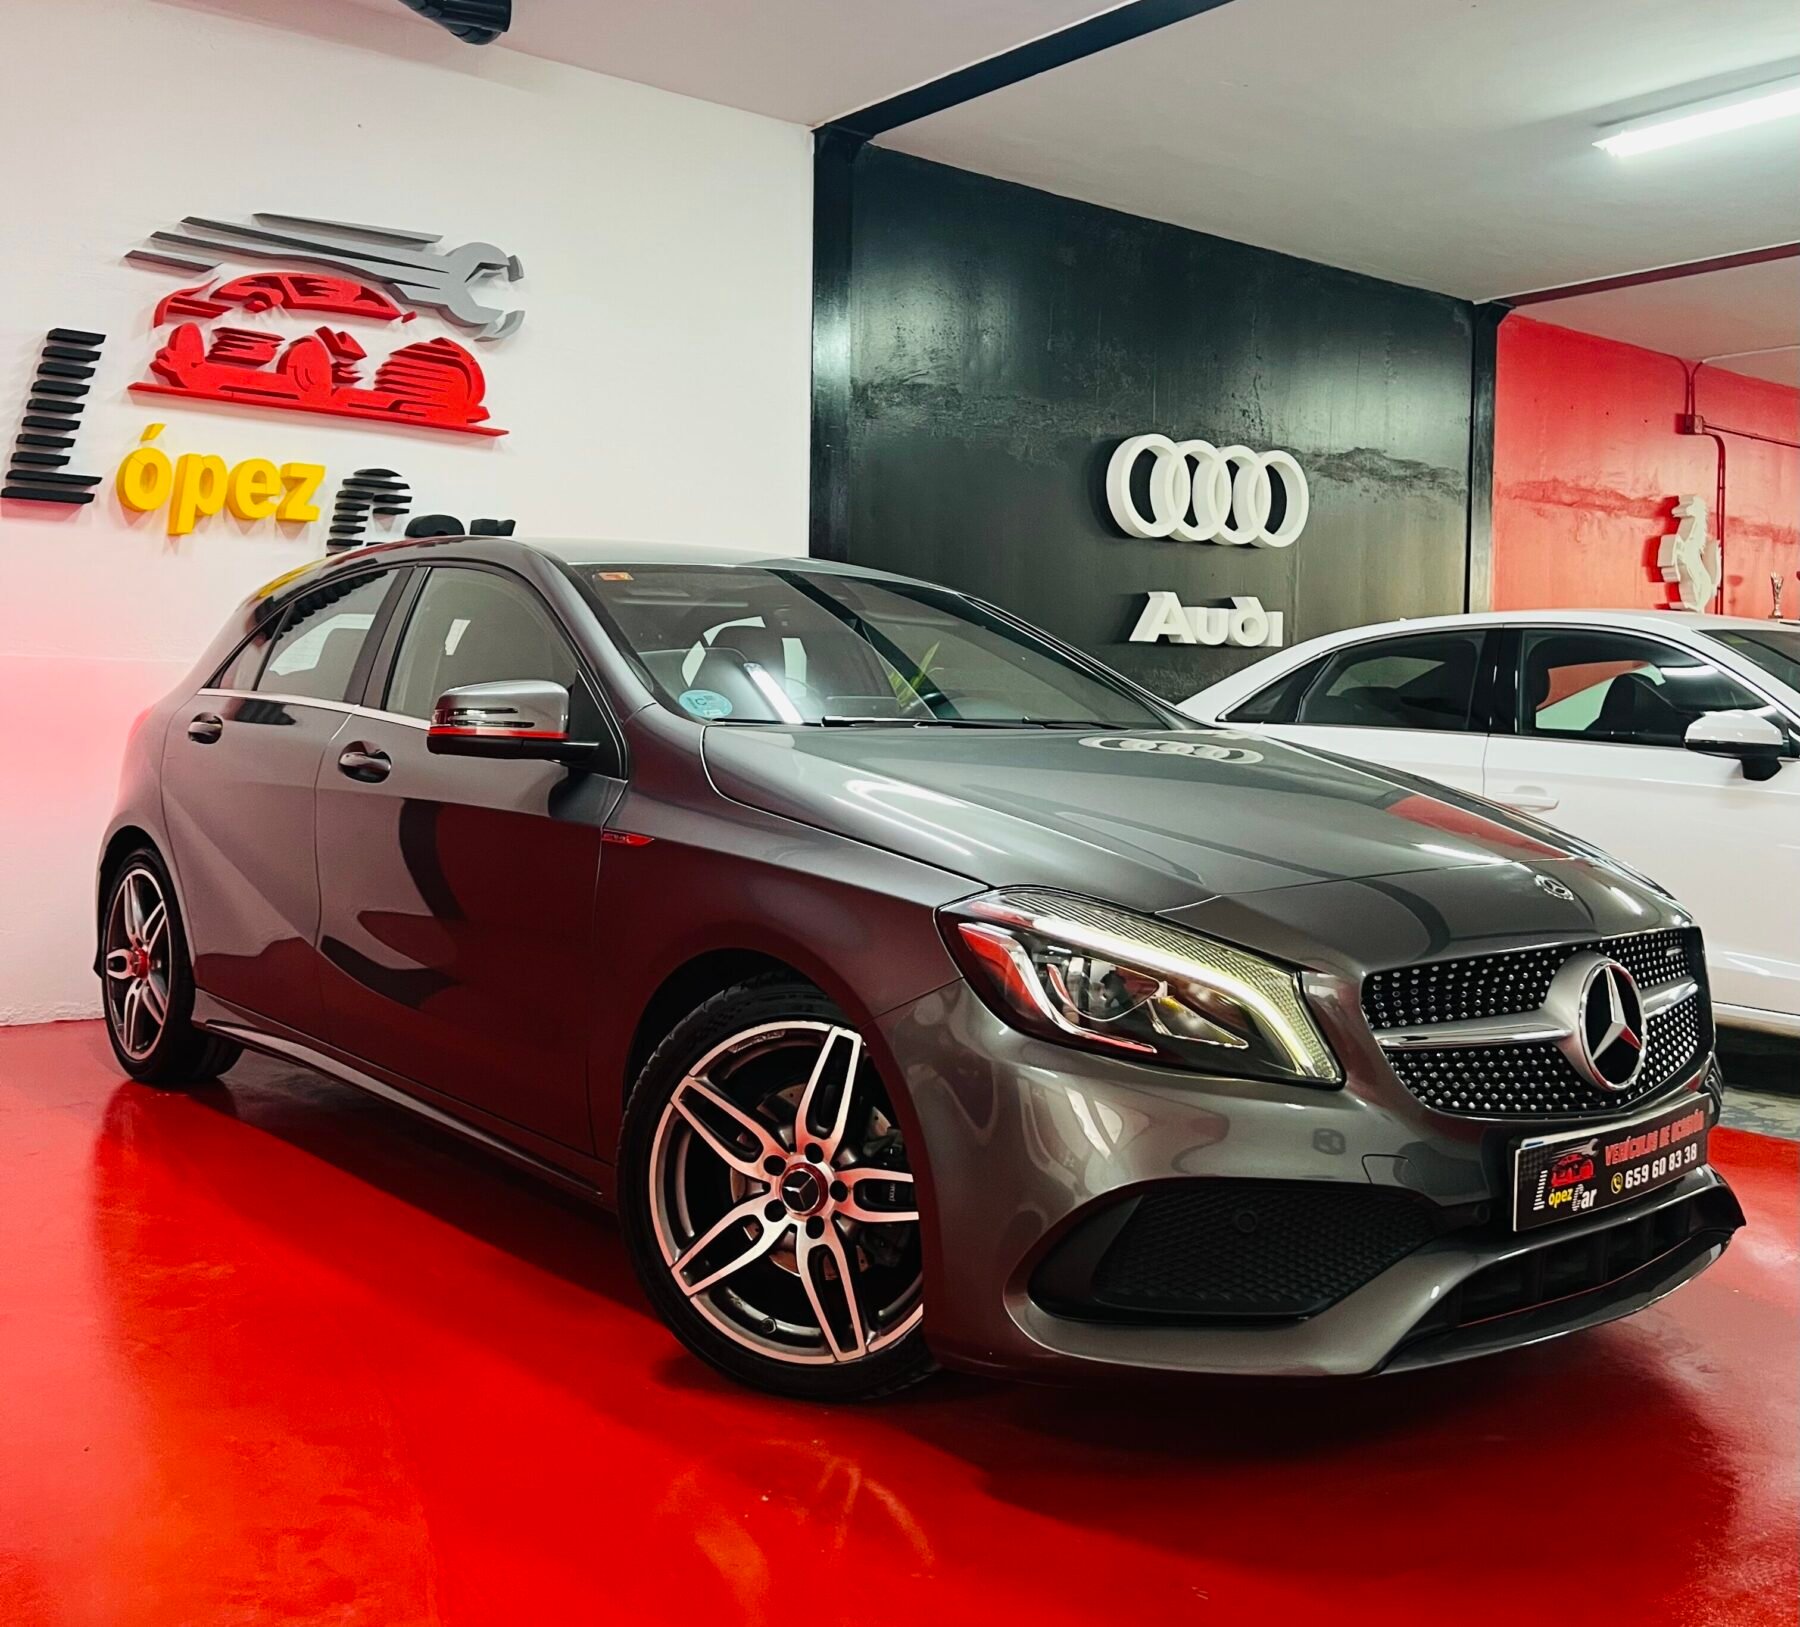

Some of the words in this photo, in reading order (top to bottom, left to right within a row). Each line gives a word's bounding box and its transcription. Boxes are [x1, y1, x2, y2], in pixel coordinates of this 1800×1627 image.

[1129, 591, 1284, 648] Audi
[1625, 1164, 1649, 1189] 659
[1652, 1157, 1666, 1177] 60
[1669, 1149, 1682, 1171] 83
[1684, 1143, 1698, 1164] 38
